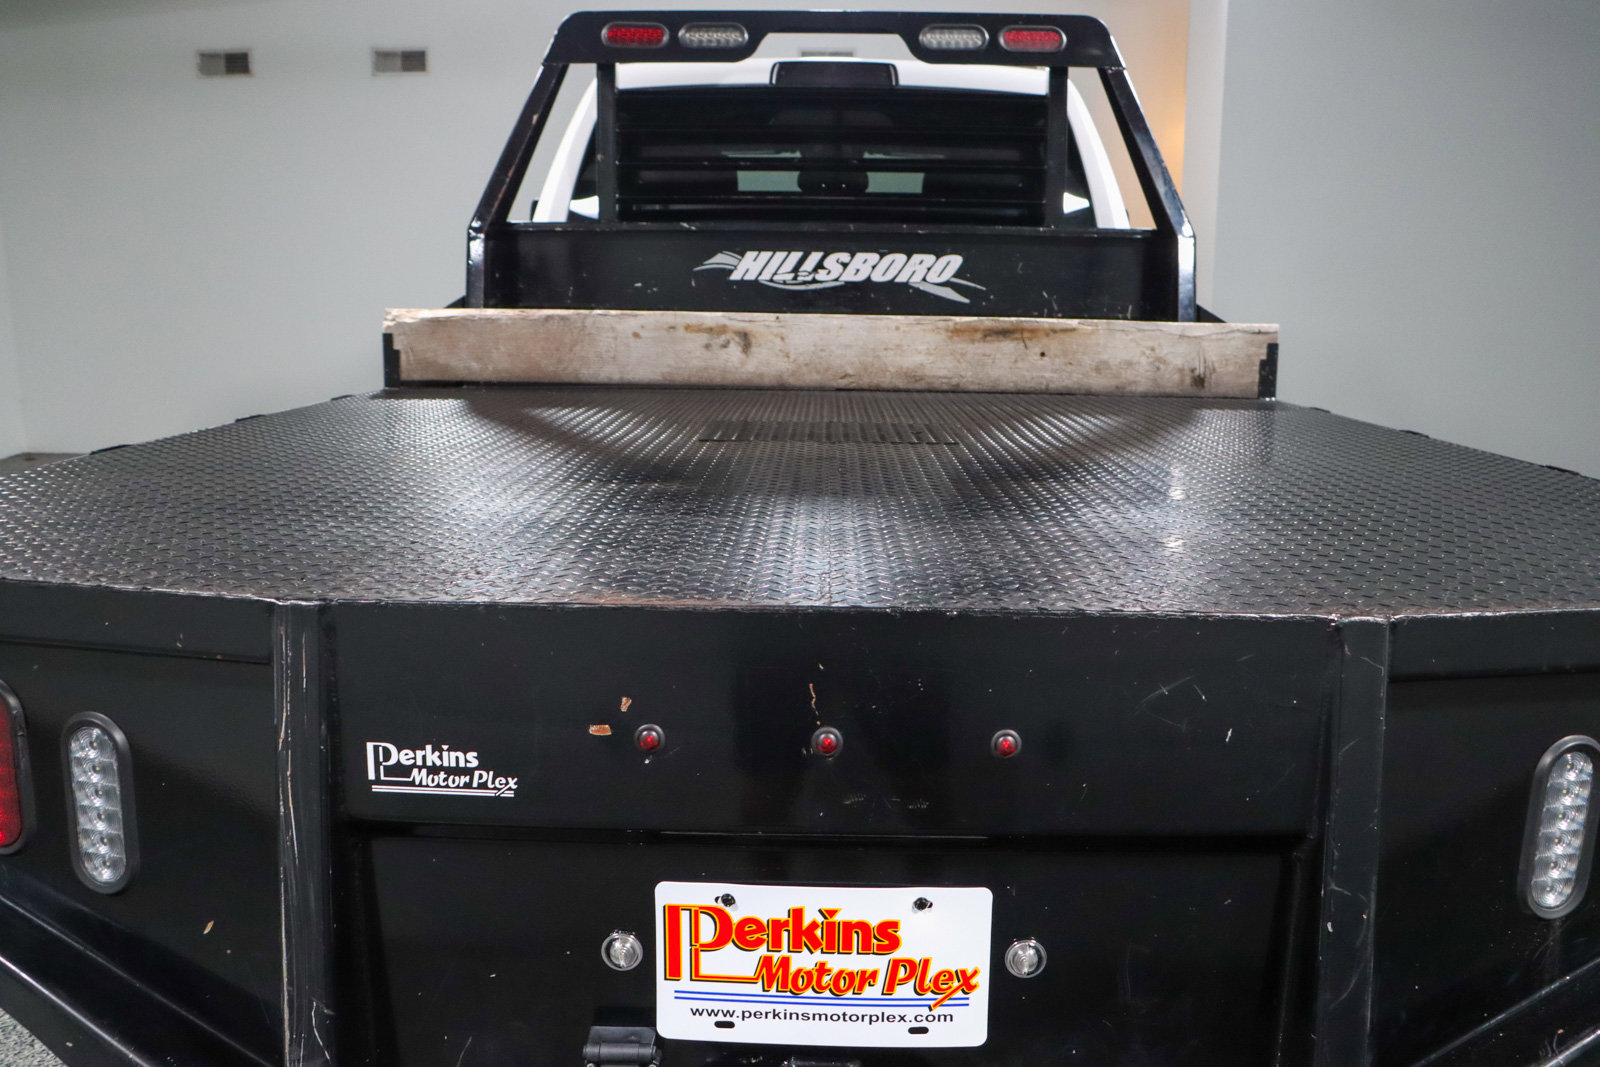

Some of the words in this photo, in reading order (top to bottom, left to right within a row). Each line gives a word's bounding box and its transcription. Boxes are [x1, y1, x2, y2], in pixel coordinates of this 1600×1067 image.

[729, 250, 964, 284] HILLSBORO
[366, 742, 479, 780] Perkins
[410, 768, 470, 788] Motor
[472, 770, 518, 797] Plex
[663, 904, 902, 981] Perkins
[754, 955, 880, 995] Motor
[882, 957, 980, 1012] Plex
[690, 1006, 954, 1026] www.perkinsmotorplex.com
